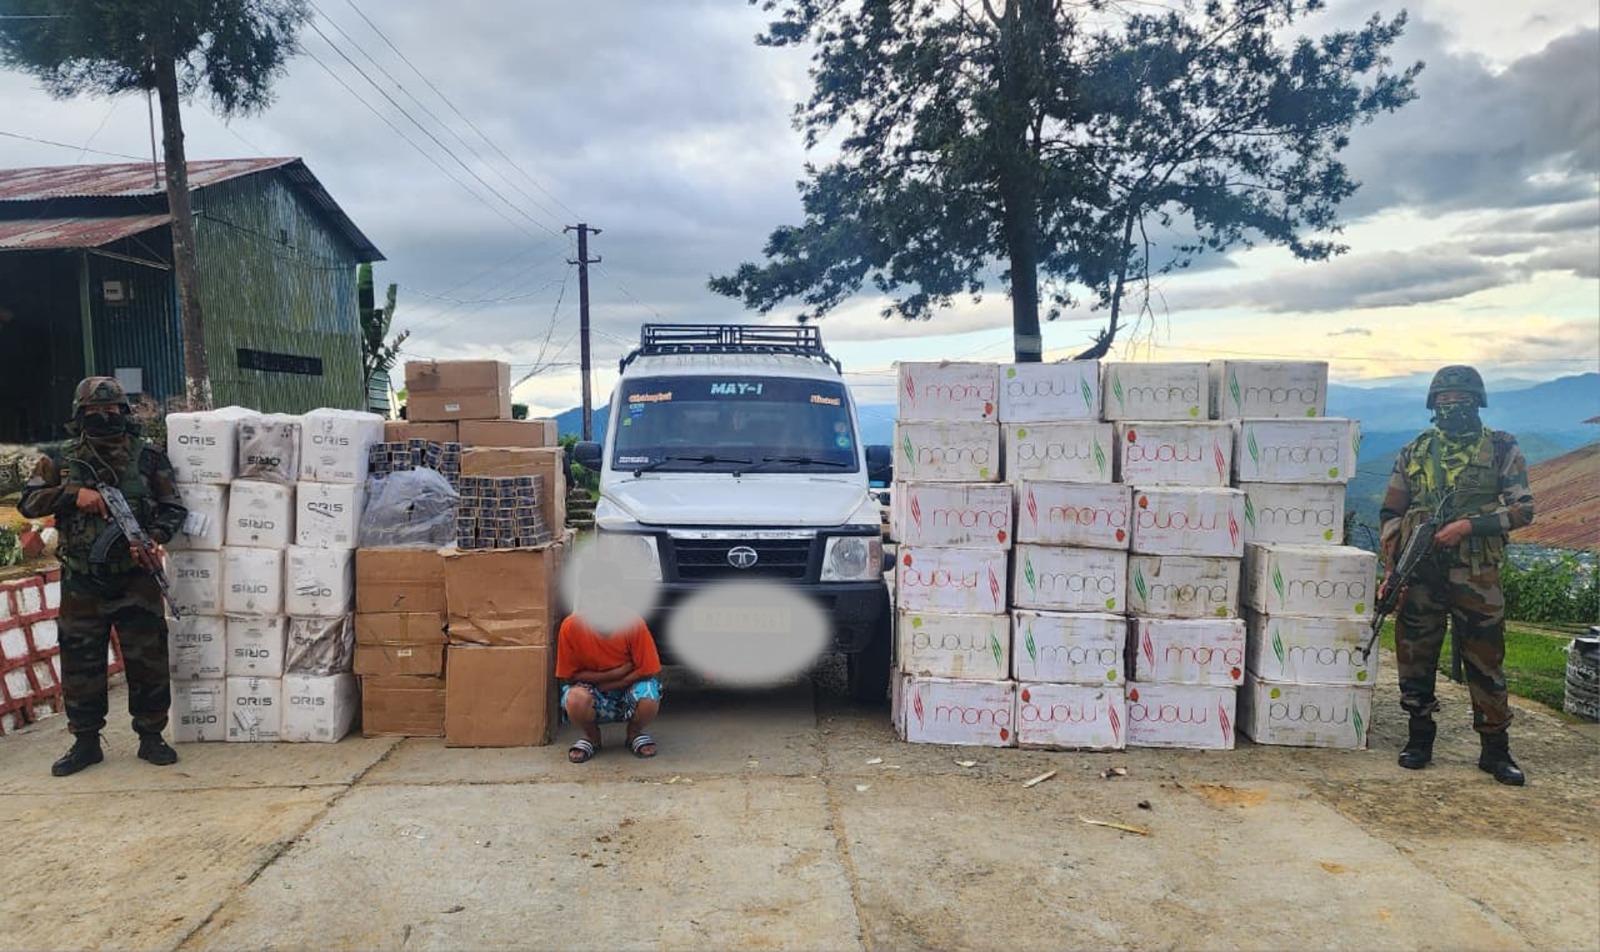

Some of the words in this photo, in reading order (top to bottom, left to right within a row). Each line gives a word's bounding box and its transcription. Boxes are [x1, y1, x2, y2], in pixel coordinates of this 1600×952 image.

[178, 435, 216, 446] ORIS
[312, 435, 350, 446] ORIS
[307, 502, 344, 514] ORIS
[238, 518, 275, 530] ORIS
[232, 584, 268, 594] ORIS
[176, 633, 213, 643] ORIS
[234, 648, 270, 659] ORIS
[236, 696, 273, 707] ORIS
[290, 695, 326, 706] ORIS
[181, 715, 217, 725] ORIS
